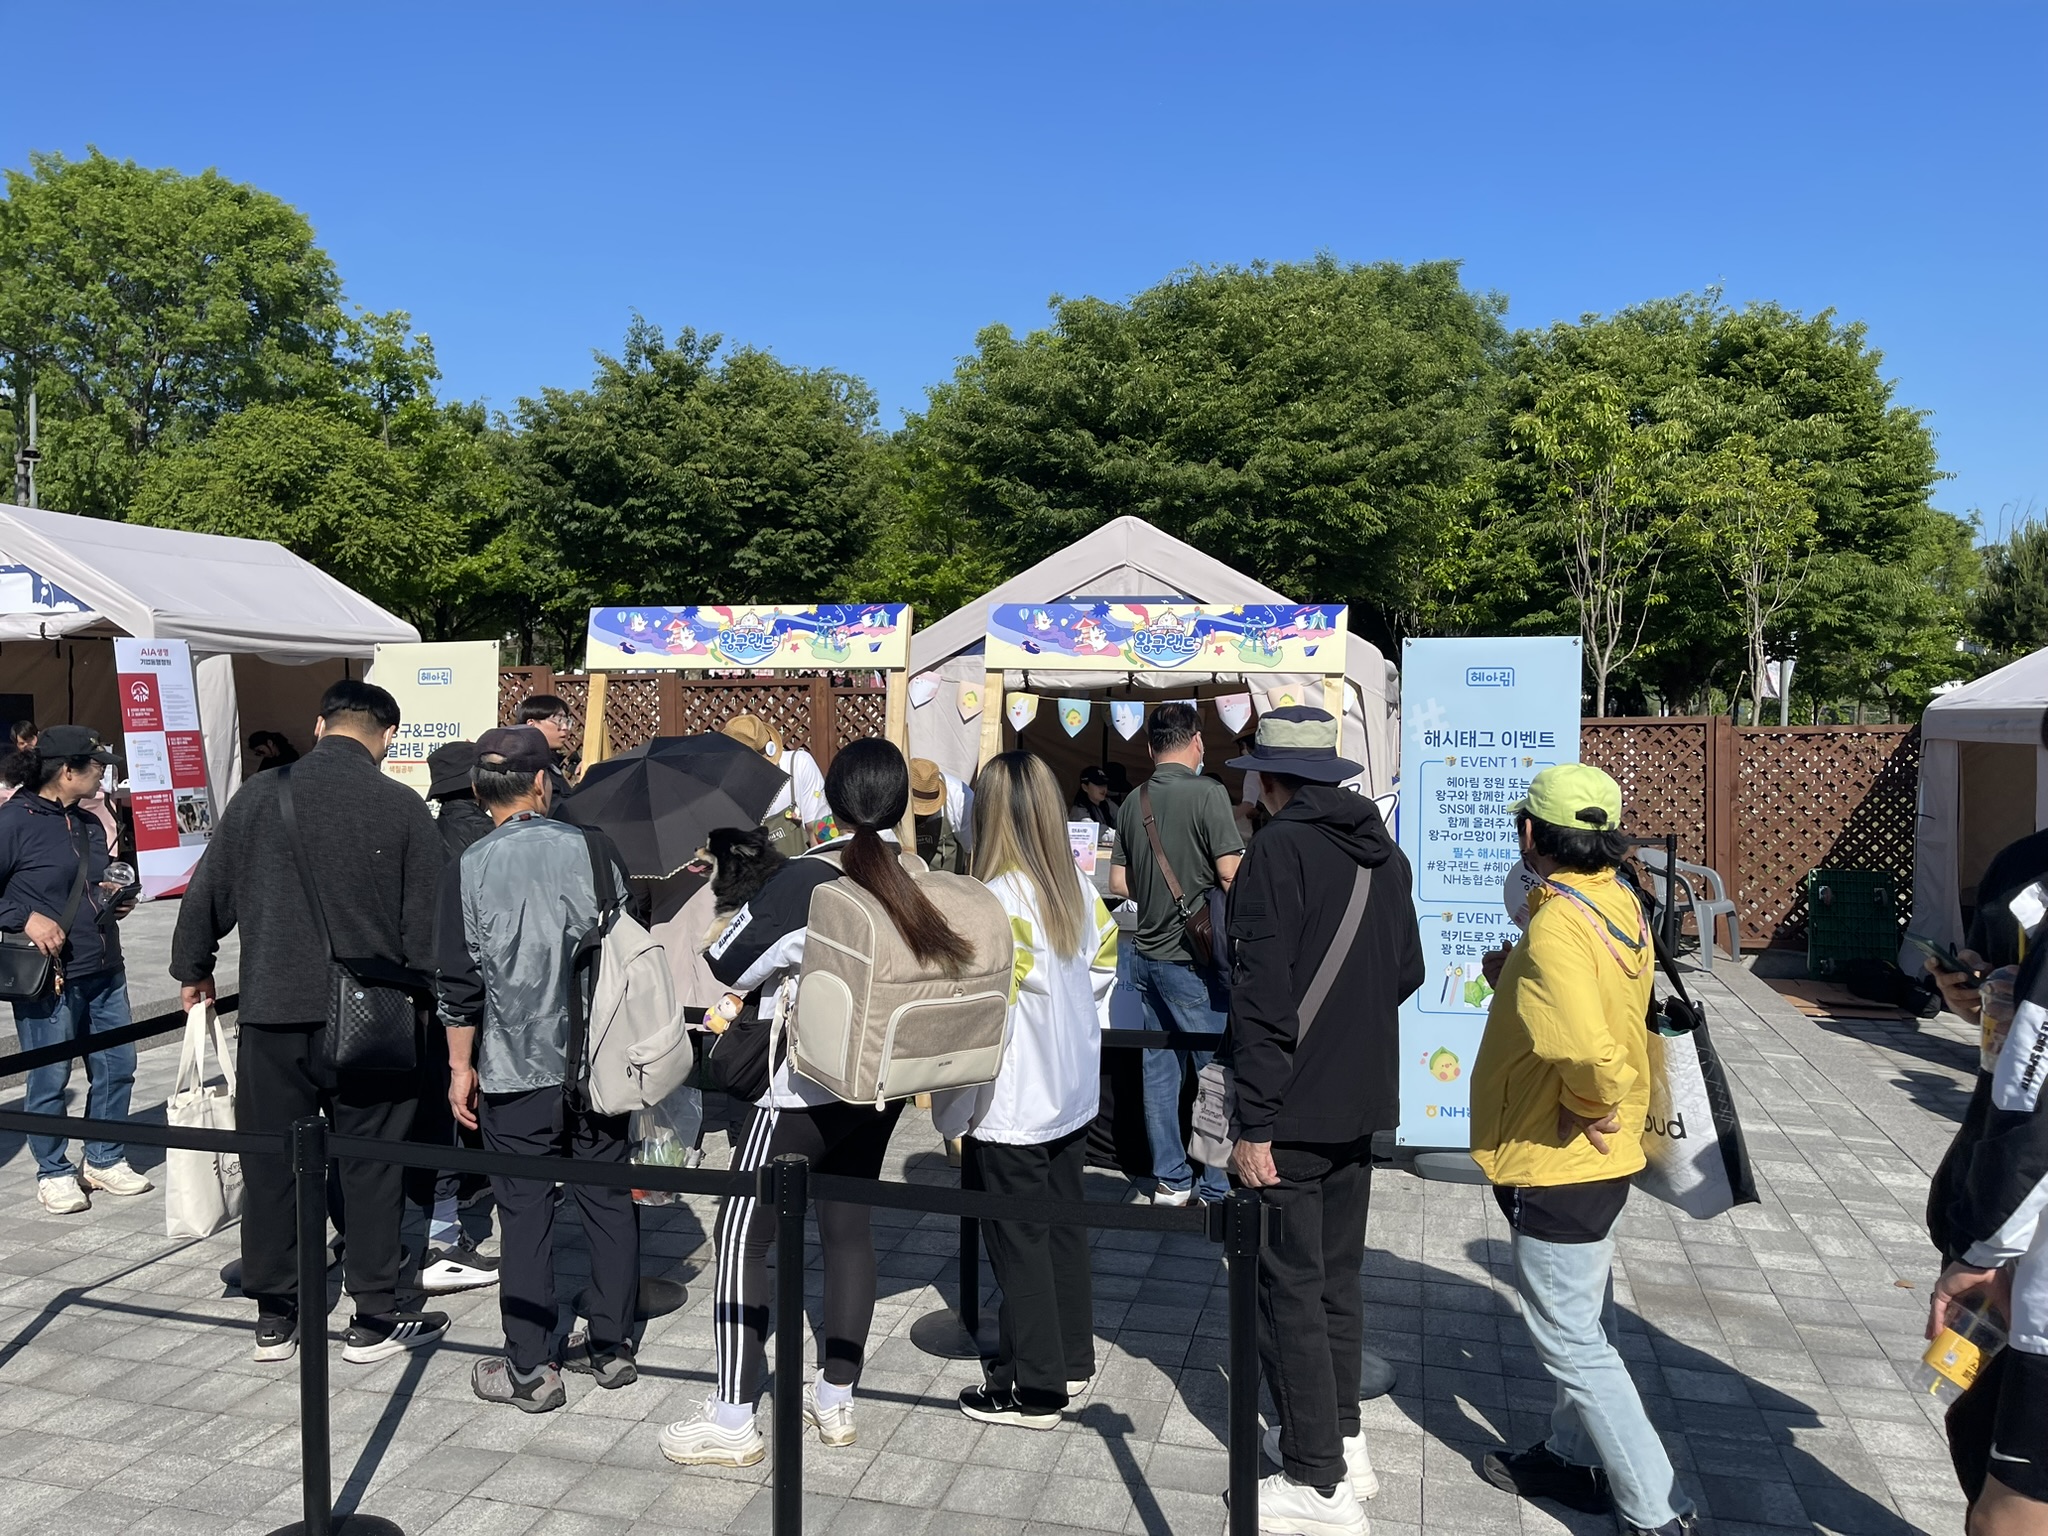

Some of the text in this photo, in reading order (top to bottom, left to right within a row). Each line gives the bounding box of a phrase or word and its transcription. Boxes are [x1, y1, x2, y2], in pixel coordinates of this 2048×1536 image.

[721, 631, 774, 651] 왕구랜드
[1135, 631, 1195, 652] 왕구랜드
[1470, 671, 1511, 687] 헤아림
[391, 722, 461, 738] 구&므앙이
[1424, 730, 1556, 749] 해시태그 이벤트
[1460, 756, 1518, 768] EVENT 1
[1446, 777, 1531, 789] 헤아림 정원 또는
[1435, 790, 1469, 802] 왕구와
[1471, 790, 1505, 802] 함께한
[1439, 803, 1476, 815] SNS에
[1447, 817, 1470, 829] 함께
[1453, 847, 1521, 860] 필수 해시태그
[1427, 861, 1480, 873] #왕구랜드
[1457, 913, 1504, 925] EVENT
[1440, 930, 1496, 943] 럭키드로우
[1455, 943, 1477, 956] 없는
